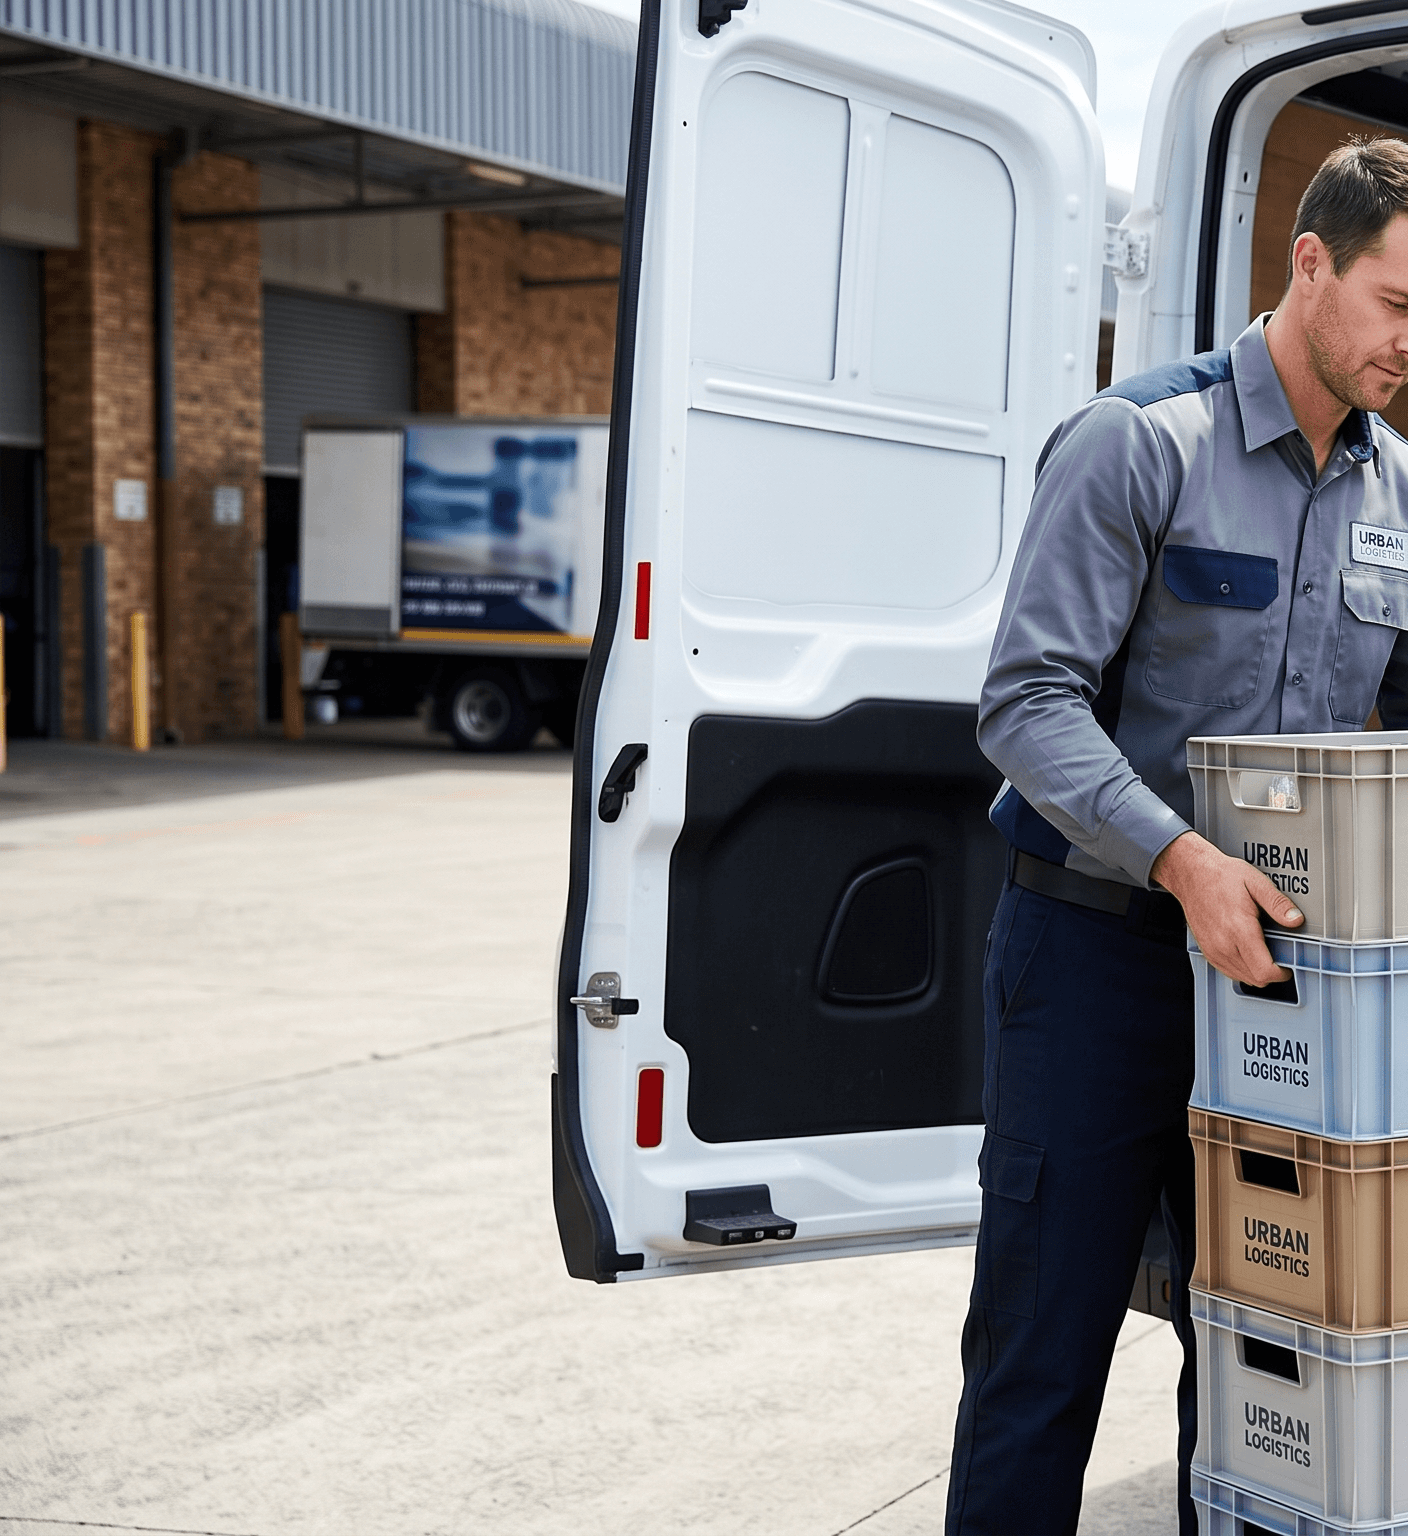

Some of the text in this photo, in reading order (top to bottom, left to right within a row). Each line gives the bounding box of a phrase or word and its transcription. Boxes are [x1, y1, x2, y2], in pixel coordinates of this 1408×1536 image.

[1359, 530, 1404, 551] URBAN
[1243, 841, 1309, 872] URBAN
[1243, 1031, 1309, 1066] URBAN
[1243, 1059, 1310, 1088] LOGISTICS
[1244, 1216, 1309, 1256] URBAN
[1244, 1244, 1310, 1278] LOGISTICS
[1244, 1401, 1310, 1446] URBAN
[1244, 1429, 1311, 1468] LOGISTICS
